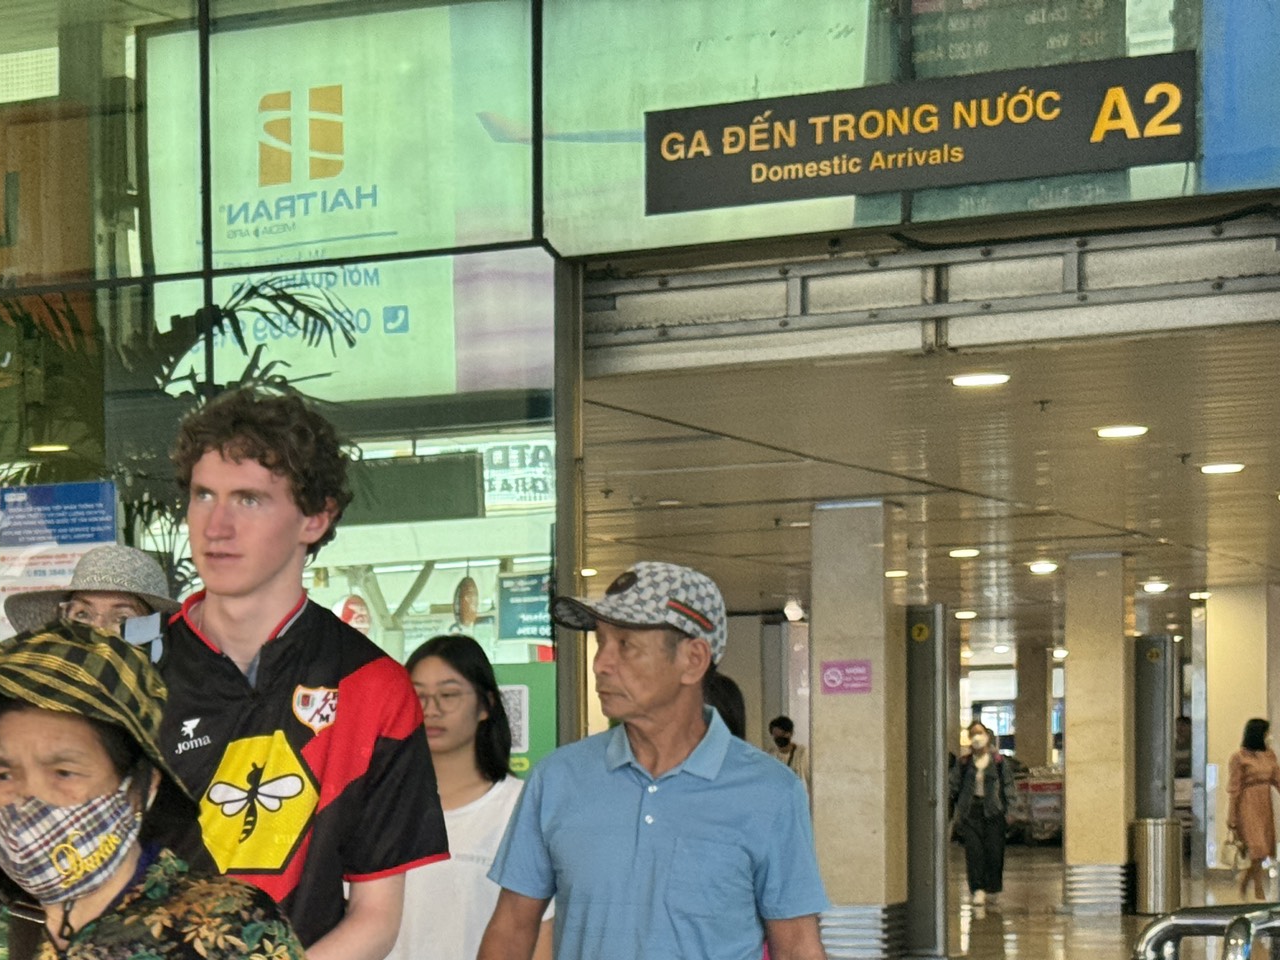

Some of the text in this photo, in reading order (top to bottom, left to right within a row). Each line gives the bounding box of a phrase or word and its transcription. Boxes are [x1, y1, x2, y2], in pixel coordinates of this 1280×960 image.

[660, 81, 1182, 162] GA ĐẾN TRONG NƯỚC A2
[750, 142, 965, 184] Domestic Arrivals
